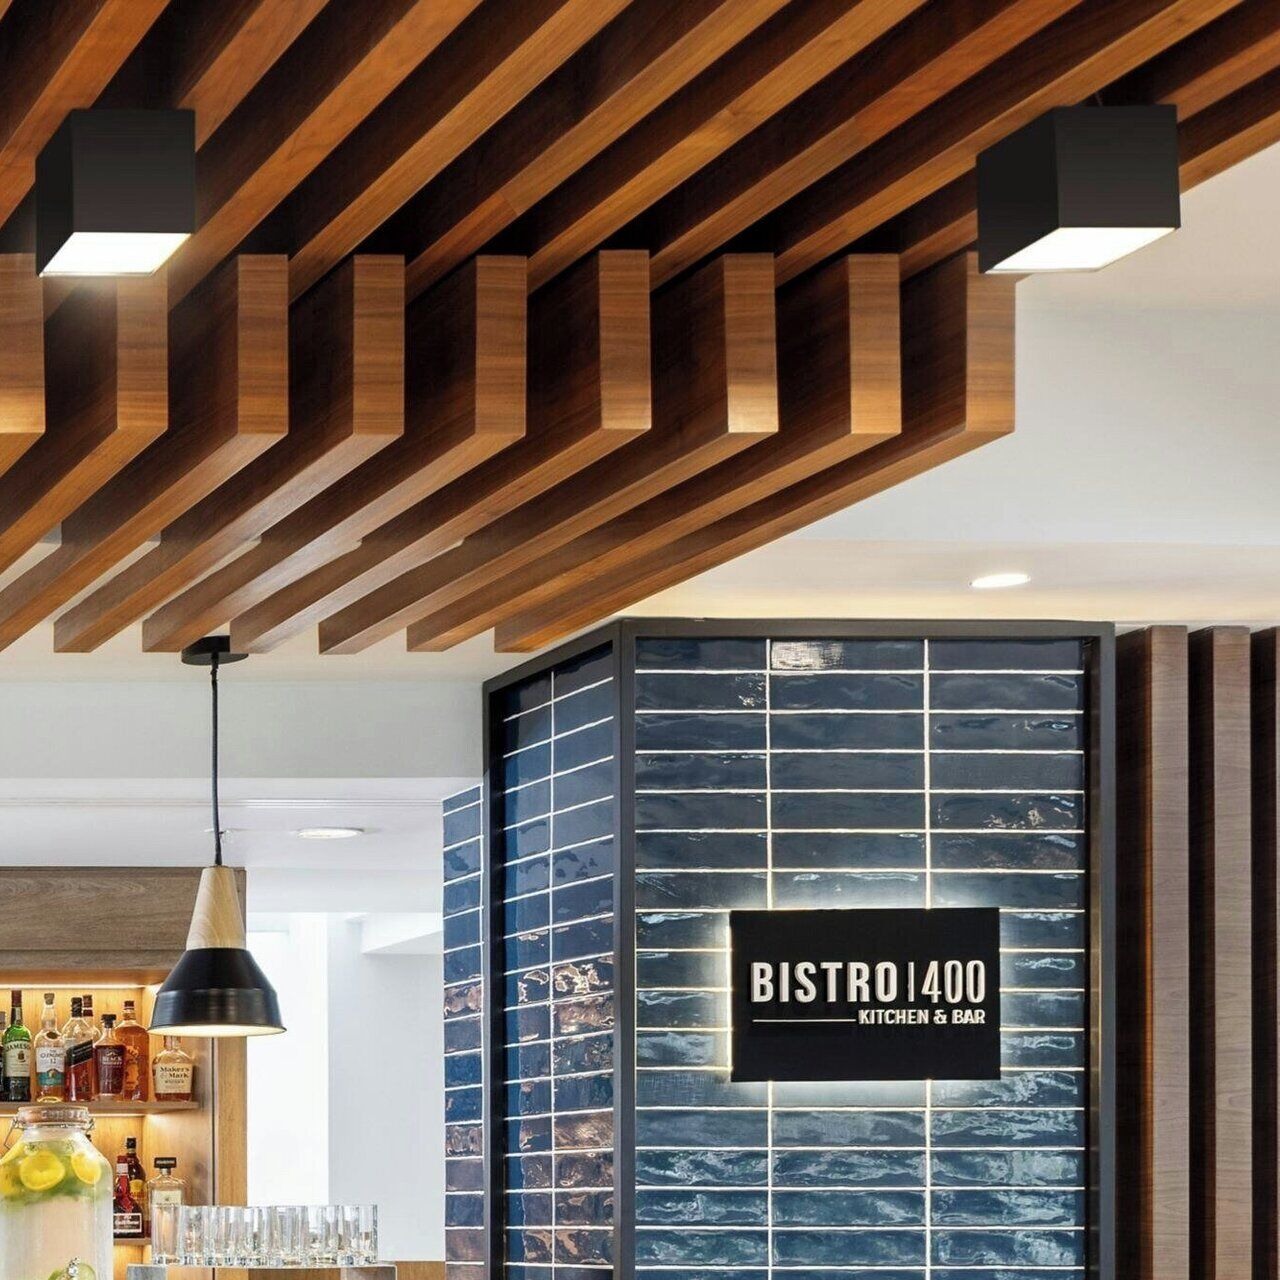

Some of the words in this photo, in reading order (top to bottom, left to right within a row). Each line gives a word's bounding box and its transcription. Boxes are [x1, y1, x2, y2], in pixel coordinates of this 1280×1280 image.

[751, 961, 898, 1003] BISTRO
[921, 960, 986, 1004] 400
[858, 1009, 930, 1025] KITCHEN
[933, 1009, 947, 1025] &
[951, 1009, 986, 1025] BAR
